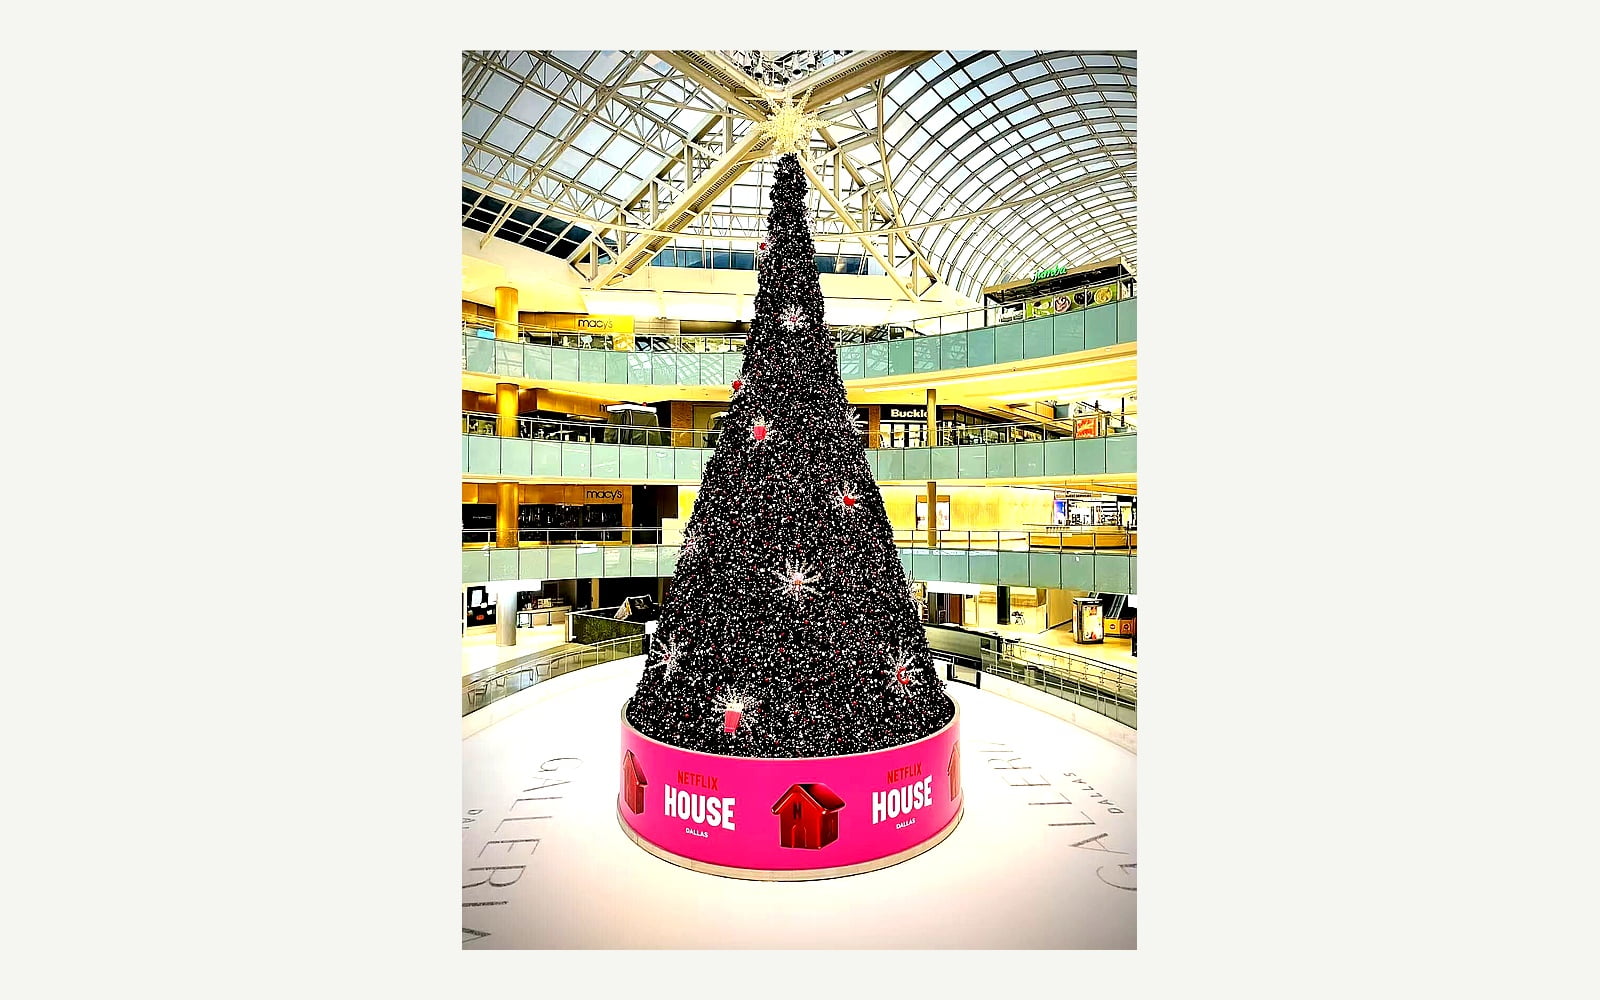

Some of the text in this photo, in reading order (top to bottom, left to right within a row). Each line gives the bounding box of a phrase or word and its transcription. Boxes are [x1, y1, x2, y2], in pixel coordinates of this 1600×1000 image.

[586, 489, 622, 501] macy's
[677, 769, 718, 791] NETFLIX
[887, 762, 922, 784] NETFLIX
[872, 774, 933, 825] HOUSE
[1063, 772, 1124, 814] DALLAS
[664, 783, 736, 831] HOUSE
[685, 827, 709, 839] DALLAS
[895, 817, 917, 830] DALLAS
